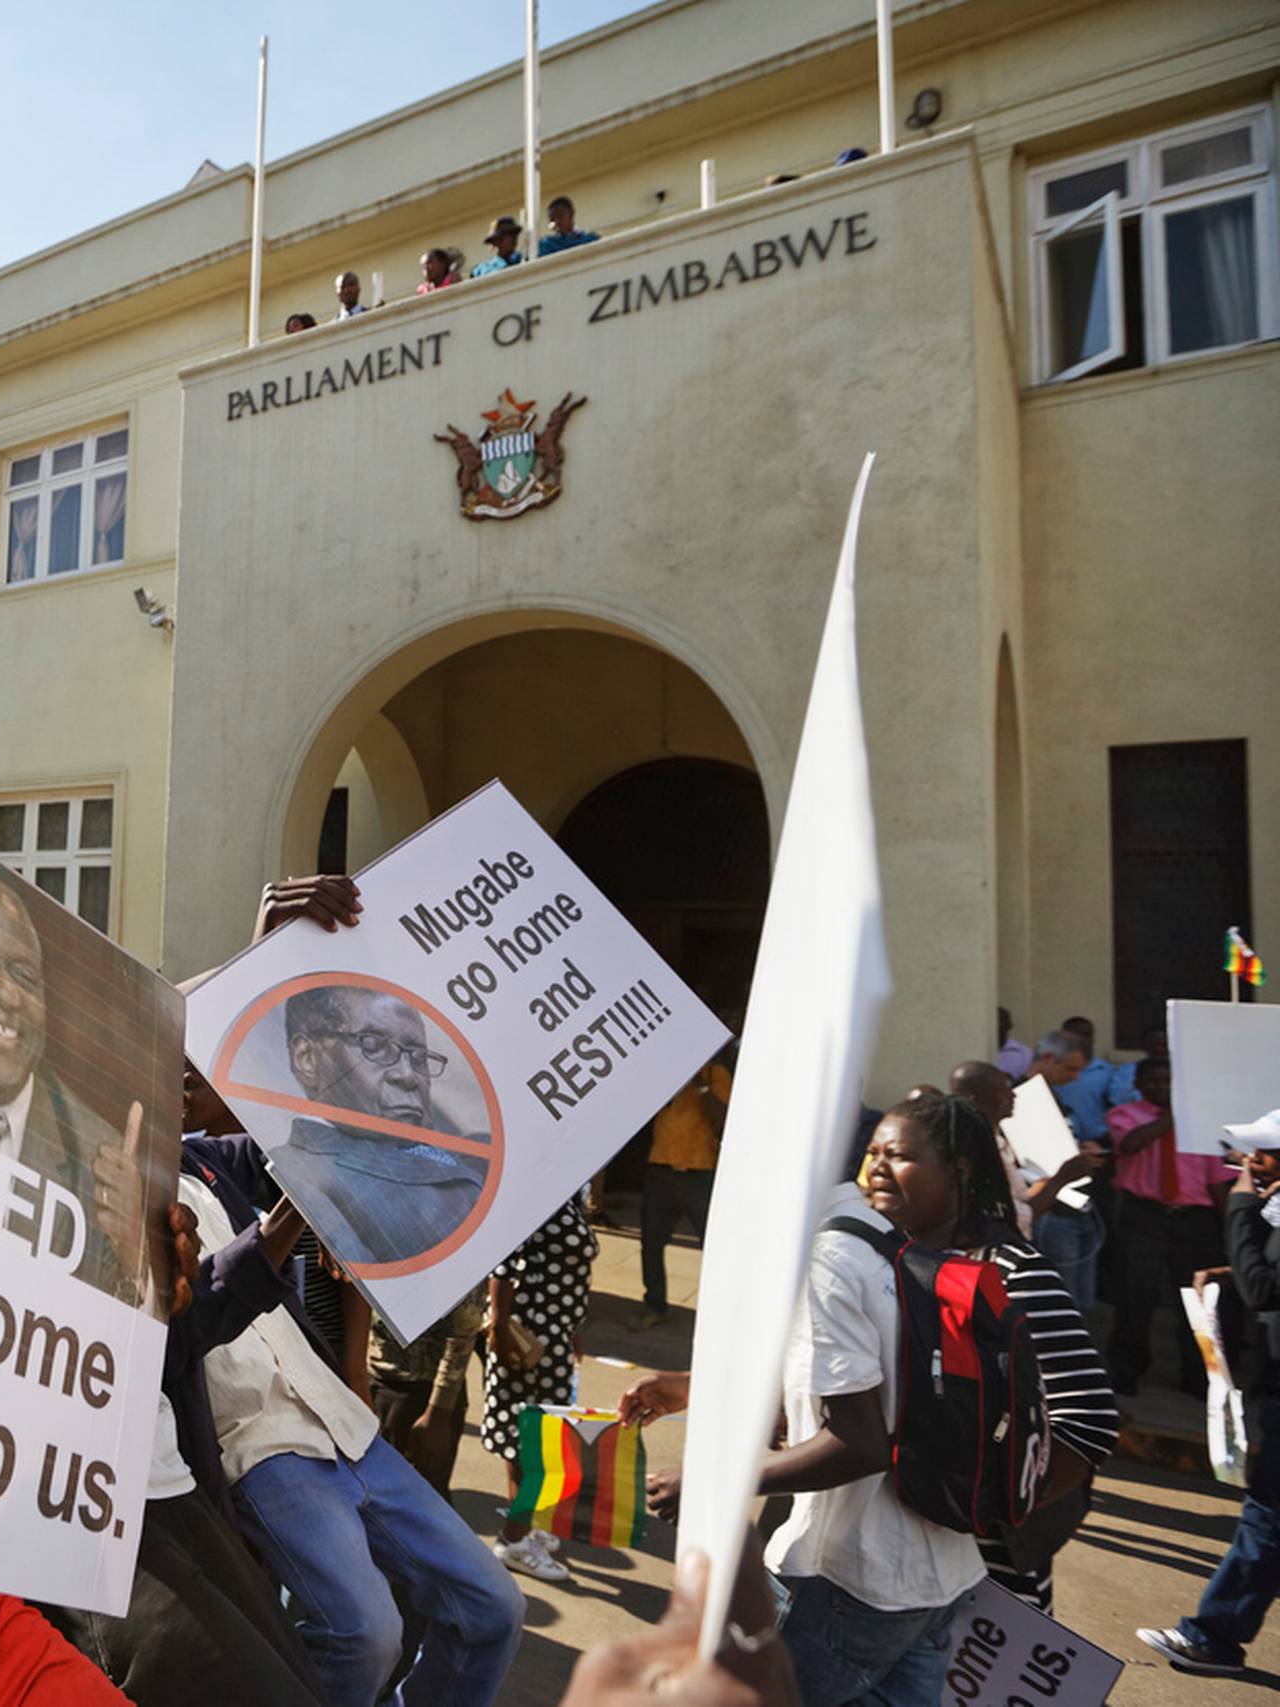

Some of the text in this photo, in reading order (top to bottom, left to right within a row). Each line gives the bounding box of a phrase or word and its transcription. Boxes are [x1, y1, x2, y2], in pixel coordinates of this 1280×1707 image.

[227, 212, 878, 422] PARLIAMENT OF ZIMBABWE
[398, 851, 535, 955] Mugabe
[446, 892, 583, 1021] go home
[529, 957, 597, 1032] and
[526, 979, 672, 1121] REST!!!!!
[36, 1443, 125, 1540] us.
[946, 1617, 1007, 1707] ome
[1019, 1643, 1078, 1698] us.
